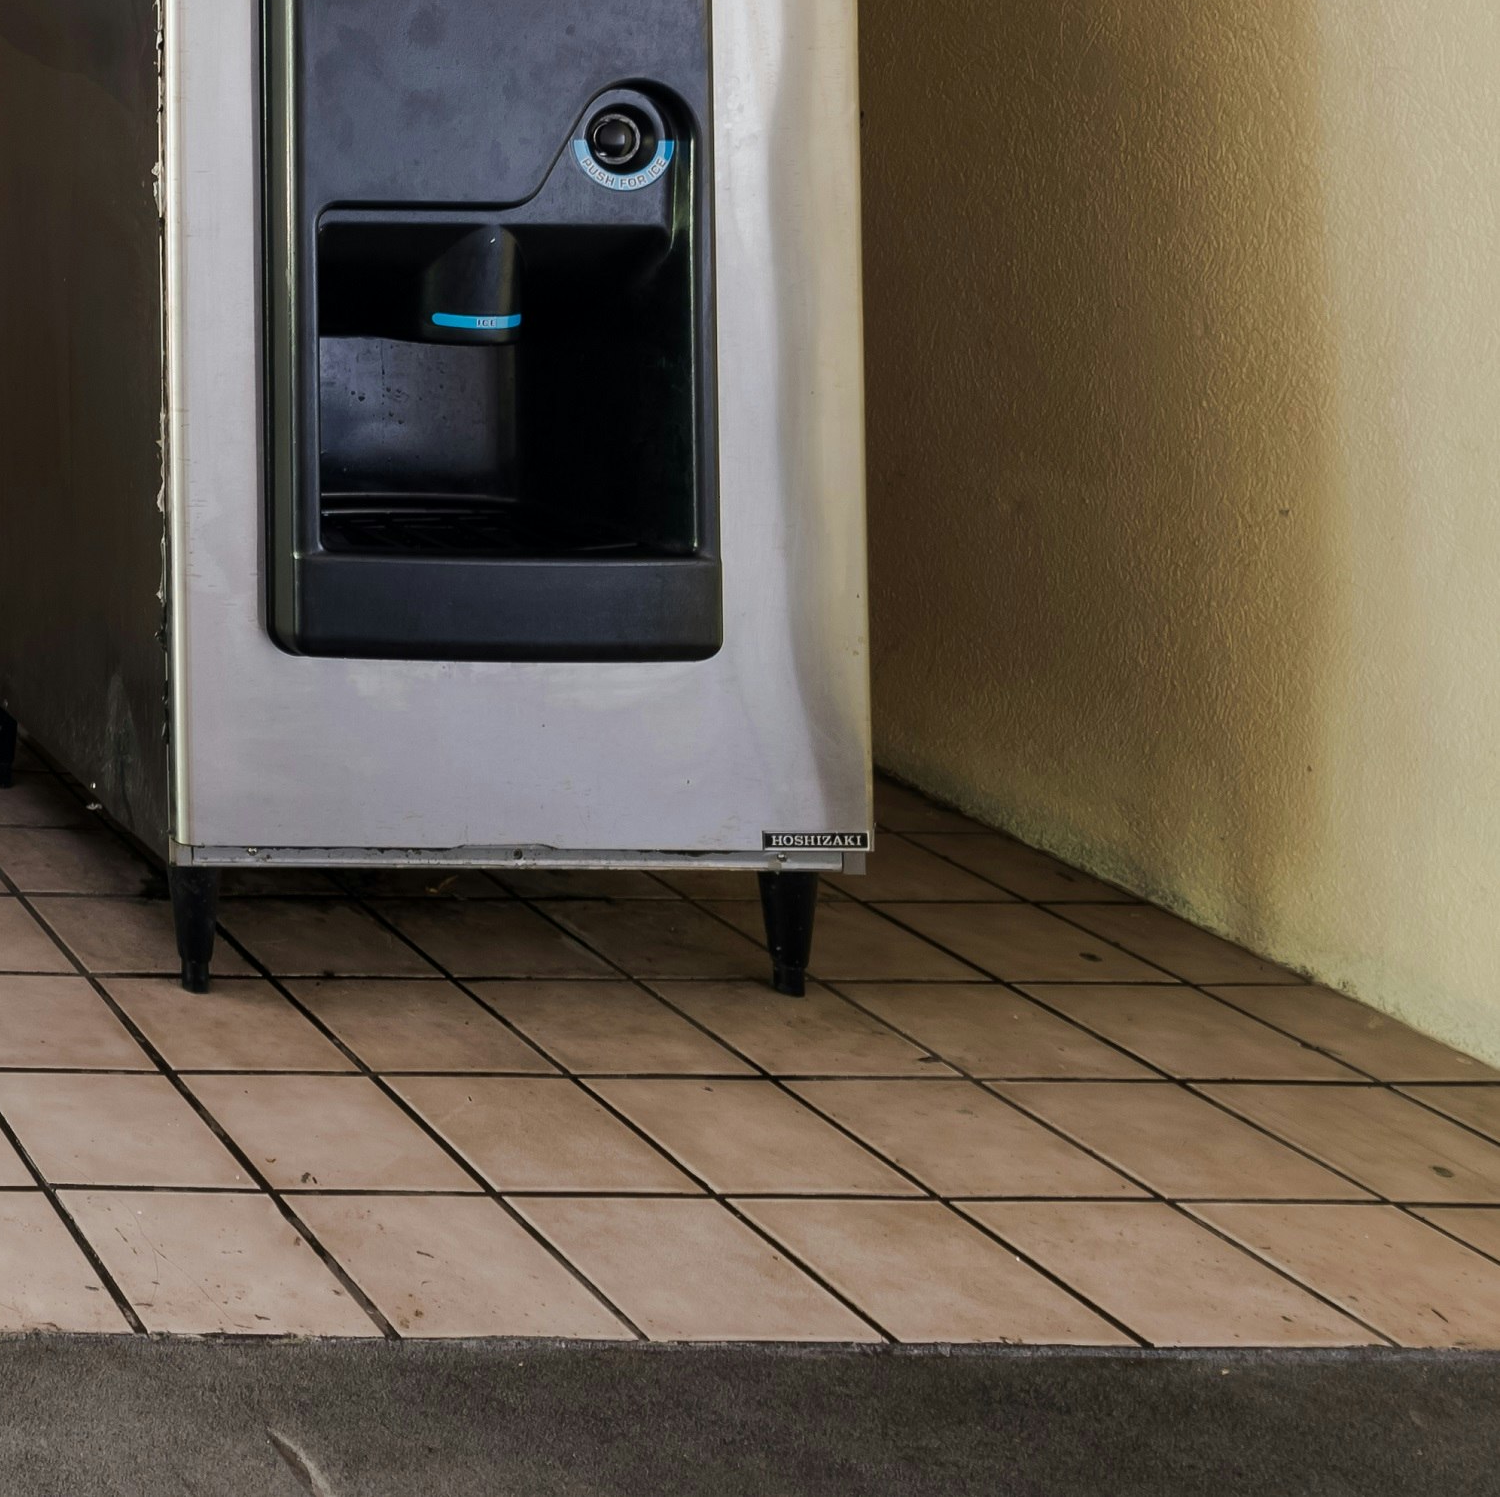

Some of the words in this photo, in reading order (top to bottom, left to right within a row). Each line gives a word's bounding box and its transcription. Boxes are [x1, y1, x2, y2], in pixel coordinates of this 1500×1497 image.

[581, 158, 615, 186] PUSH
[620, 175, 646, 188] FOR
[648, 158, 666, 178] ICE
[771, 835, 862, 846] HOSHIZAKI
